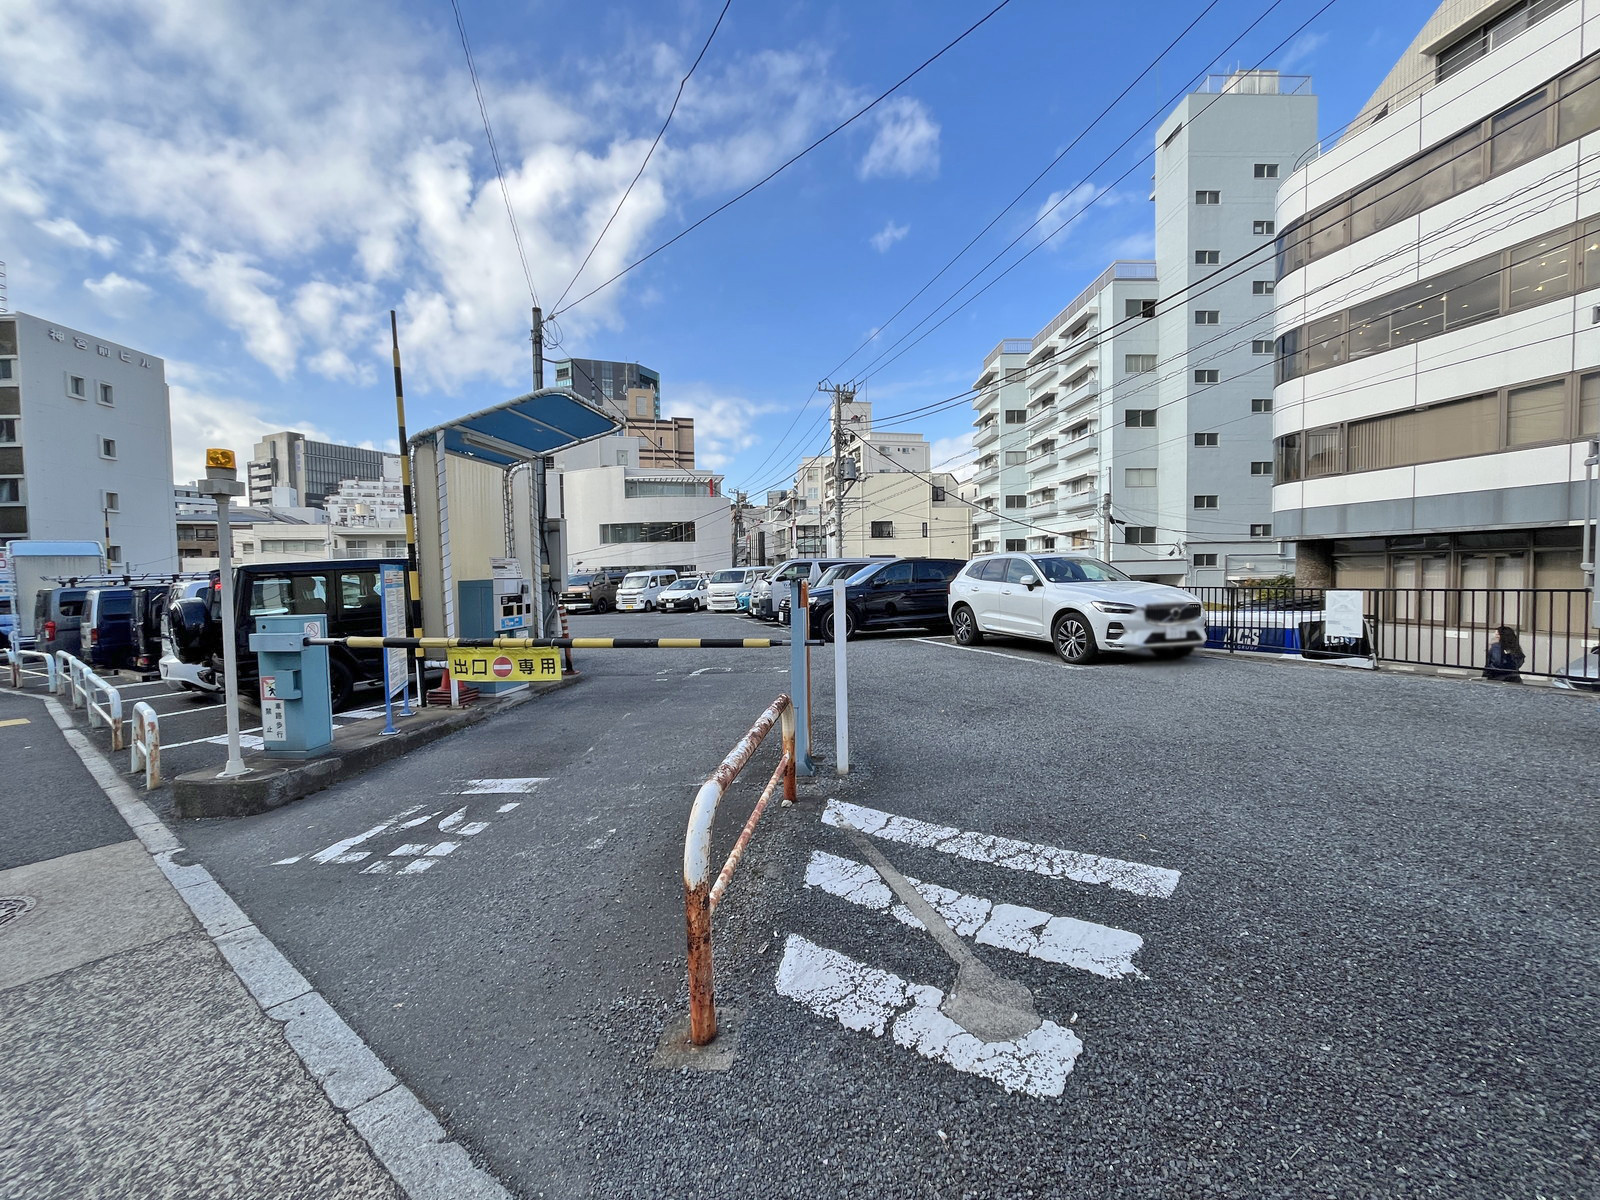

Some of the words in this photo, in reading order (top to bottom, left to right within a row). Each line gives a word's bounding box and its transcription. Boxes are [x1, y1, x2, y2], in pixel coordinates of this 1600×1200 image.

[454, 658, 487, 676] 出口
[517, 657, 556, 676] 専用
[265, 707, 273, 733] 禁止
